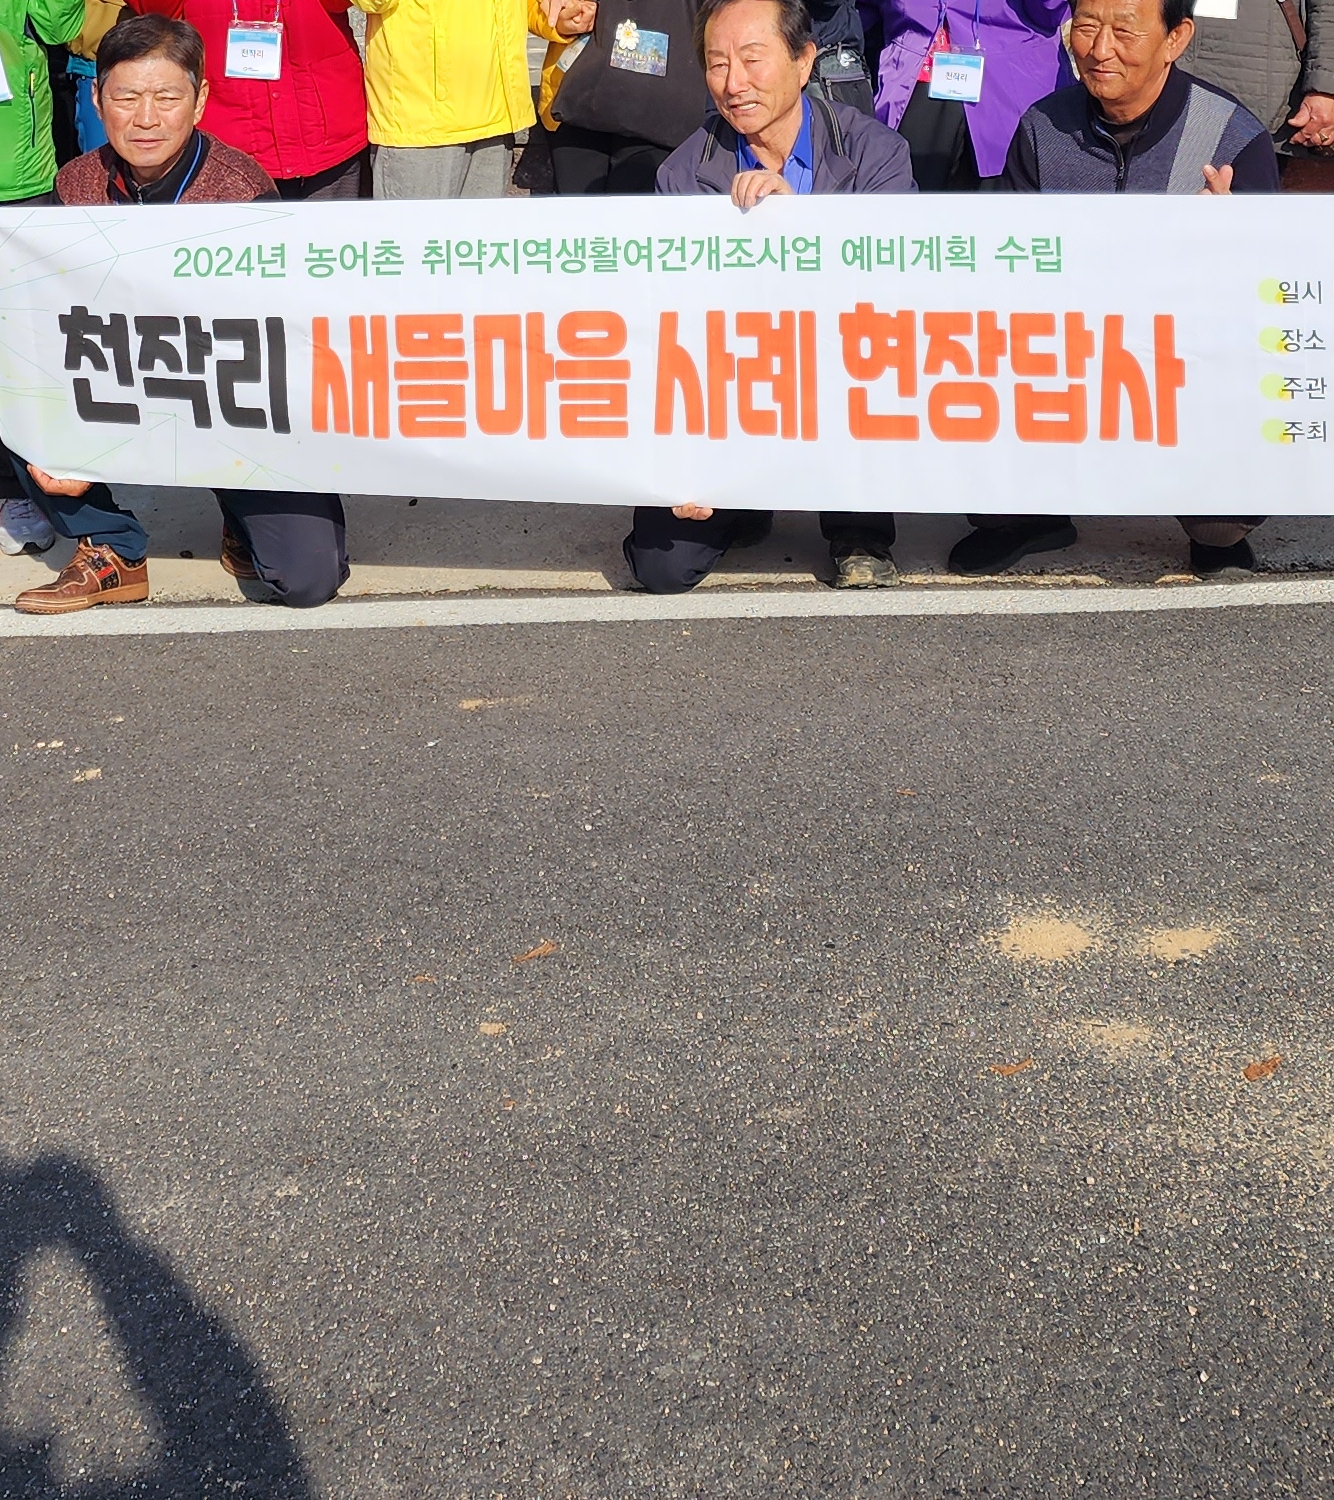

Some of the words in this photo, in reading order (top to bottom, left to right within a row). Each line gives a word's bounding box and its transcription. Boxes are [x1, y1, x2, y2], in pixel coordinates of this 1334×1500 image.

[173, 242, 287, 279] 2024년
[304, 240, 405, 278] 농어촌
[420, 235, 822, 276] 취약지역생활여건개조사업
[841, 235, 977, 273] 예비계획
[994, 236, 1063, 273] 수립
[1278, 281, 1322, 305] 일시
[1280, 329, 1326, 354] 장소
[58, 304, 292, 435] 천작리
[311, 310, 631, 440] 새뜰마을
[654, 310, 819, 442] 사례
[838, 301, 1186, 448] 현장답사
[1281, 376, 1328, 400] 주관
[1282, 420, 1328, 443] 주최
